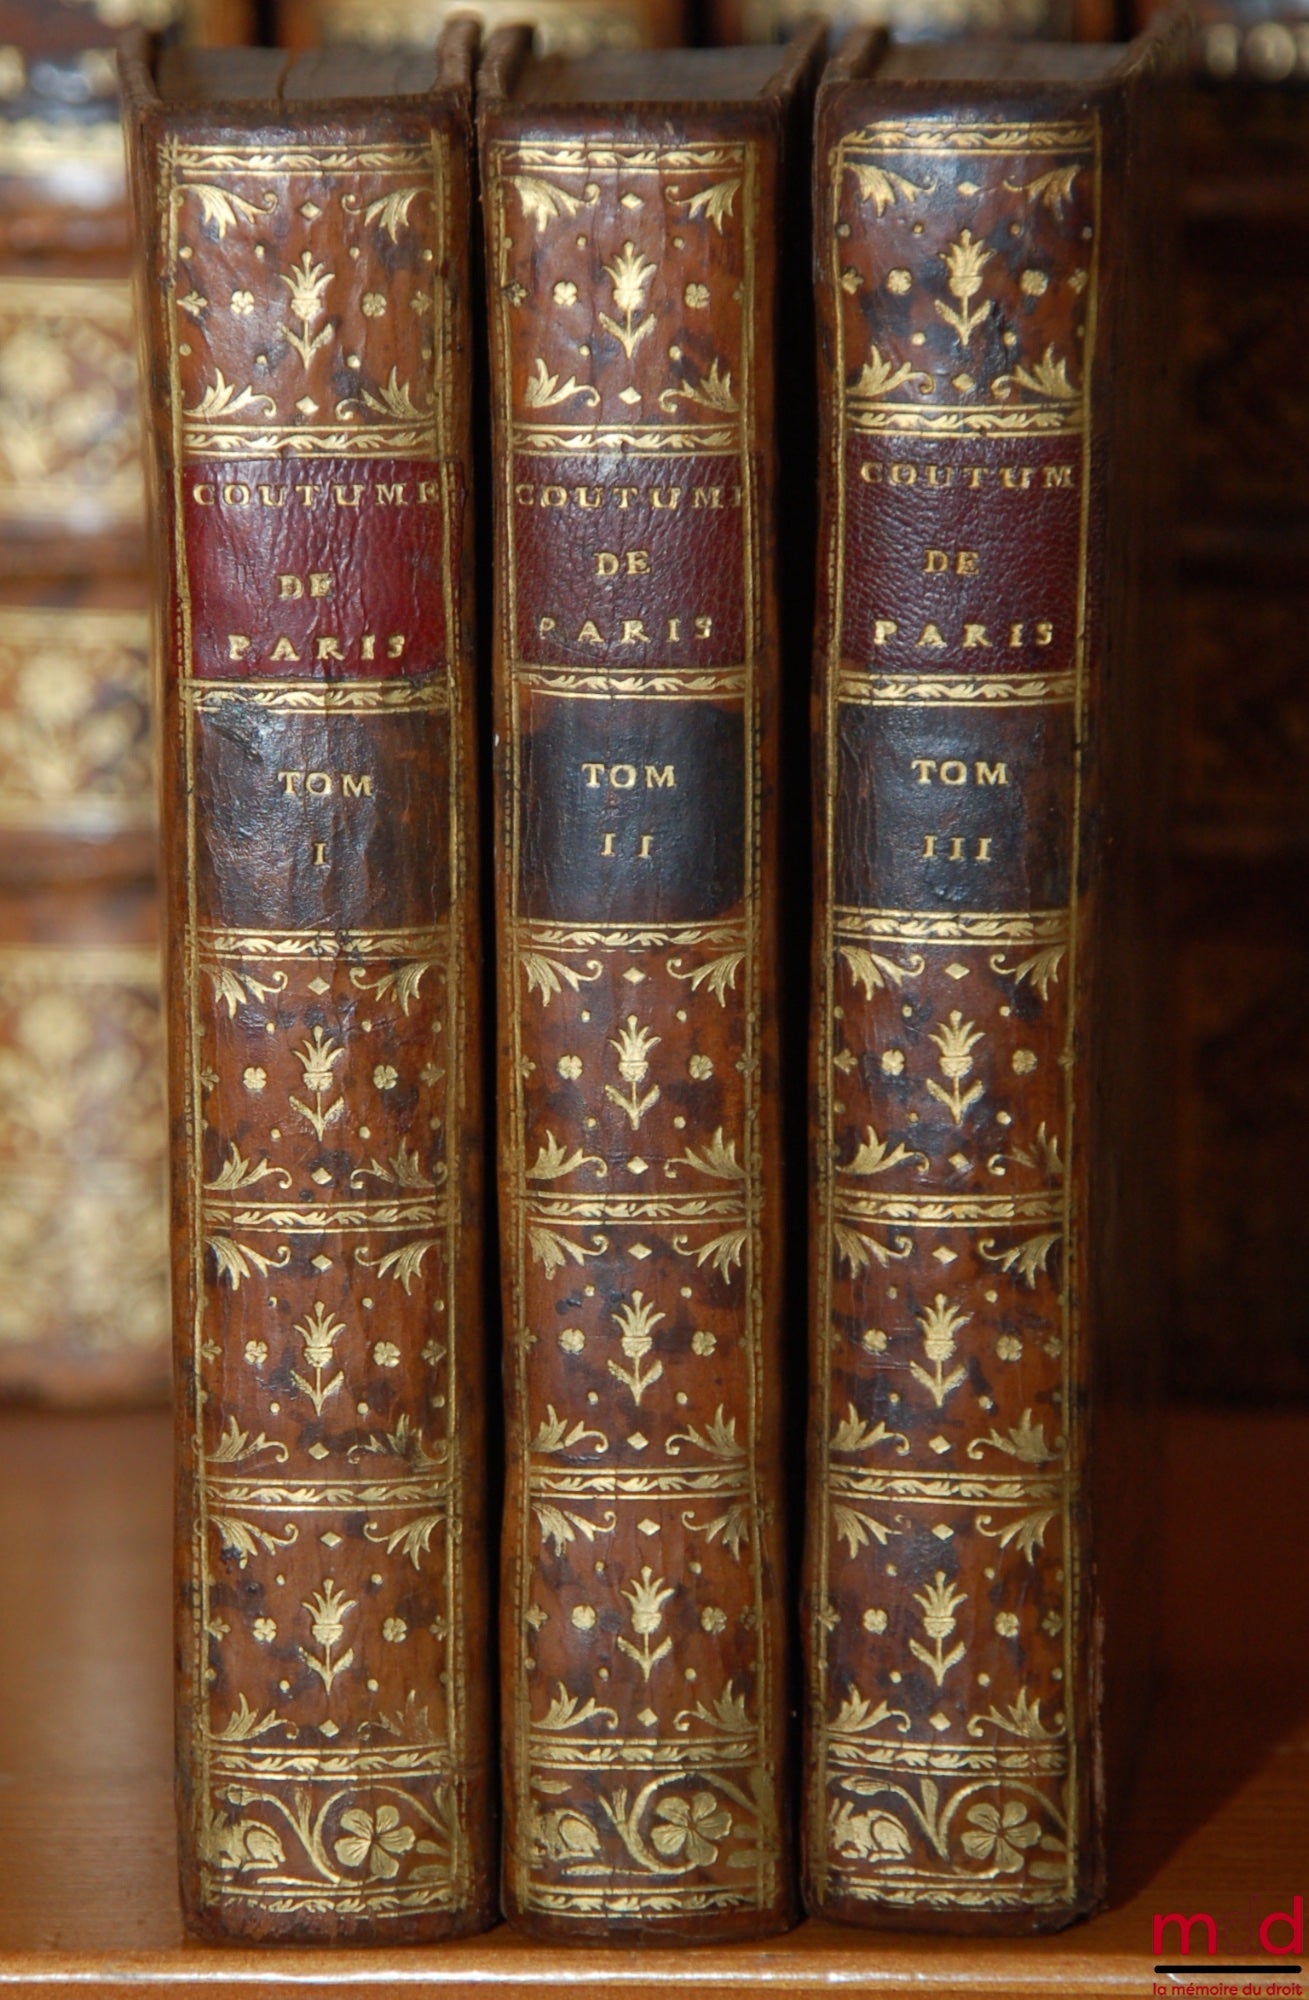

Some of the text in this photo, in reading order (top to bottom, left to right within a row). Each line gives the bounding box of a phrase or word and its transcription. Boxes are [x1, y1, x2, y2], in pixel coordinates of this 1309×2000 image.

[594, 550, 651, 576] DE
[924, 547, 980, 575] DE
[277, 572, 333, 598] DE
[539, 617, 712, 644] PARIS
[874, 619, 1053, 648] PARIS
[228, 634, 405, 661] PARIS
[279, 770, 373, 798] TOM
[582, 762, 678, 790] TOM
[912, 759, 1009, 788] TOM
[314, 841, 327, 867] I
[602, 831, 654, 860] II
[923, 833, 993, 863] III
